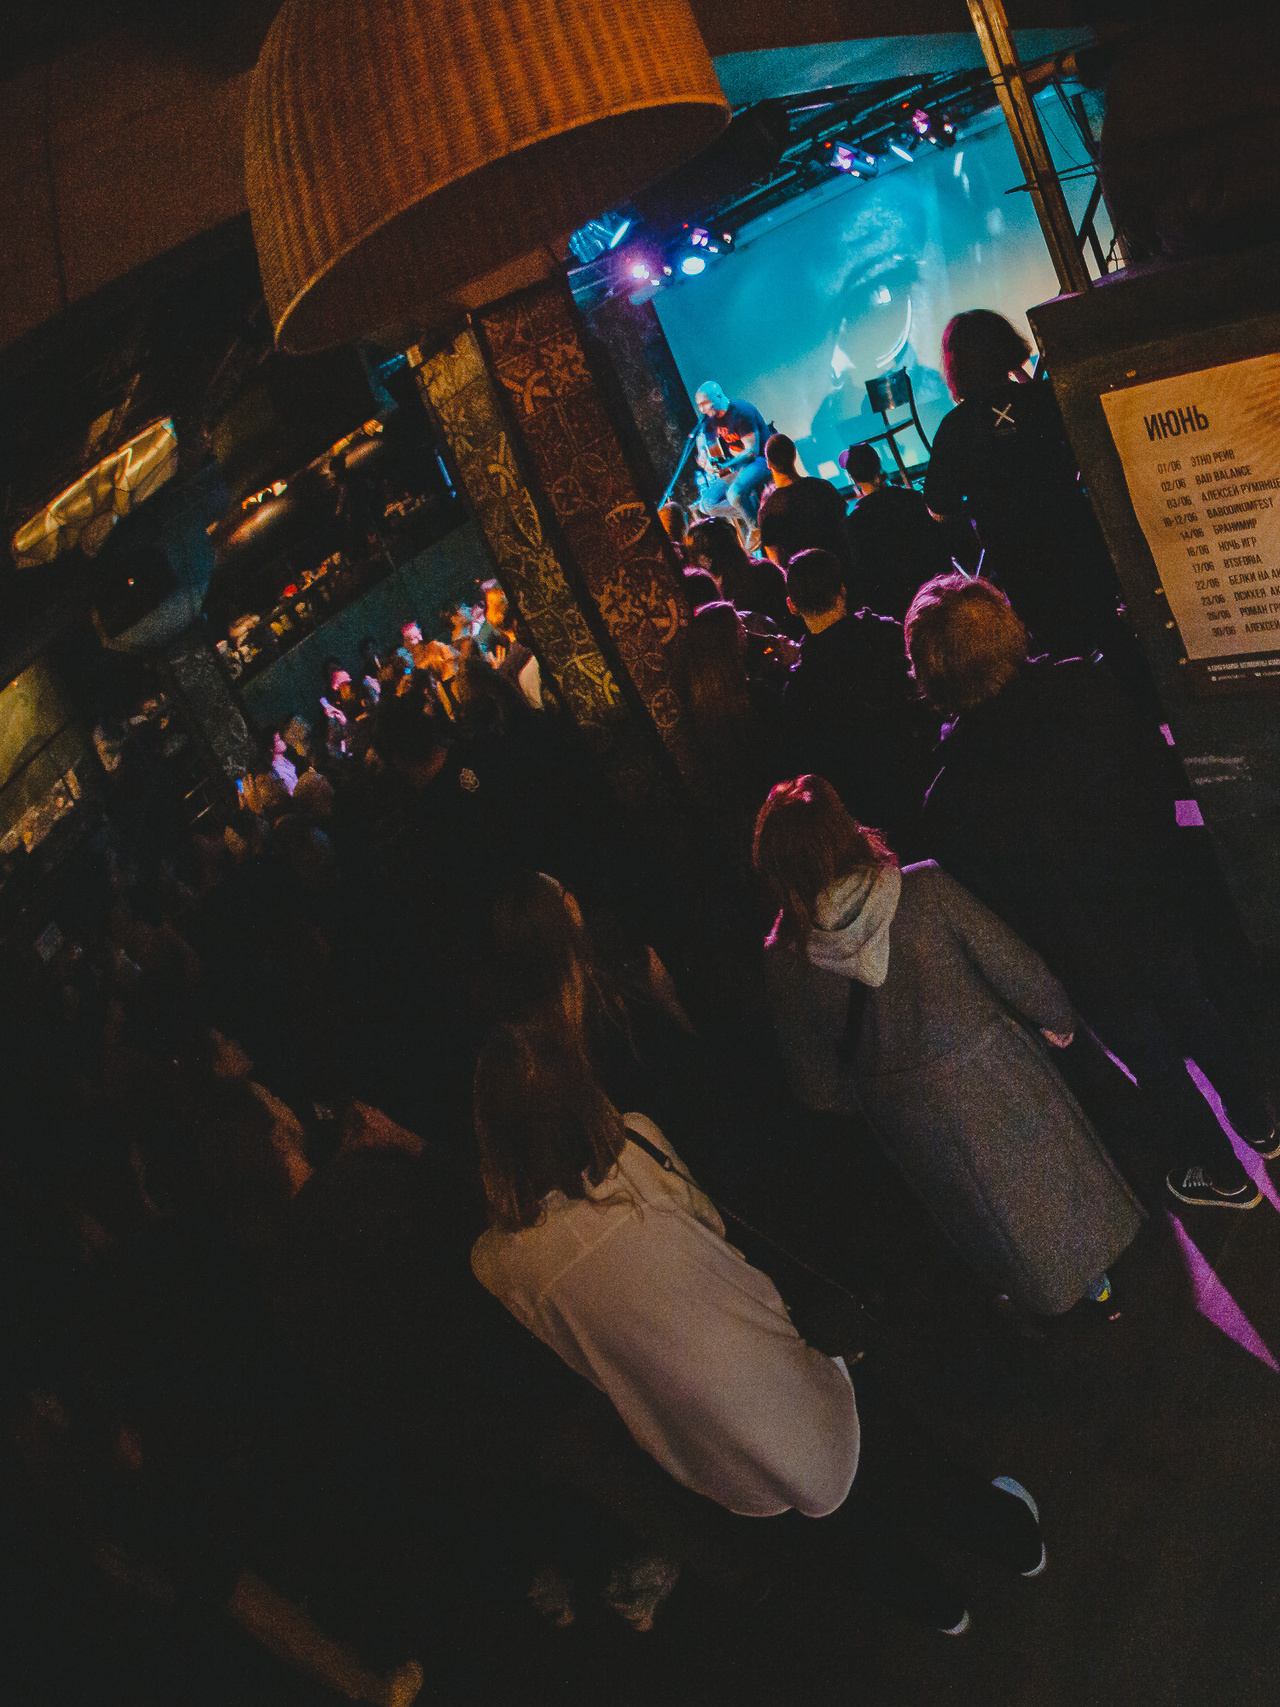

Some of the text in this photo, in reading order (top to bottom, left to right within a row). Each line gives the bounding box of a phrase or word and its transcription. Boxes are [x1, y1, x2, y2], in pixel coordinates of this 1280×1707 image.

[1143, 405, 1209, 441] ИЮНЬ
[1157, 449, 1235, 474] 01/06 ЭТНО РЕЙВ
[1161, 465, 1252, 492] 02/06 BAD BALANCE
[1166, 495, 1192, 509] 03/06
[1201, 485, 1239, 502] АЛЕКСЕЙ
[1180, 518, 1258, 541] 14/06 БРАНИМИР
[1218, 539, 1240, 551] НОЧЬ
[1240, 537, 1257, 548] ИГР
[1192, 561, 1215, 573] 17/06
[1194, 577, 1220, 591] 22/06
[1228, 572, 1256, 585] БЕЛКИ
[1258, 570, 1270, 581] НА
[1234, 588, 1267, 601] ПСИХЕЯ
[1239, 604, 1268, 617] РОМАН
[1244, 619, 1280, 633] АЛЕКСЕЙ
